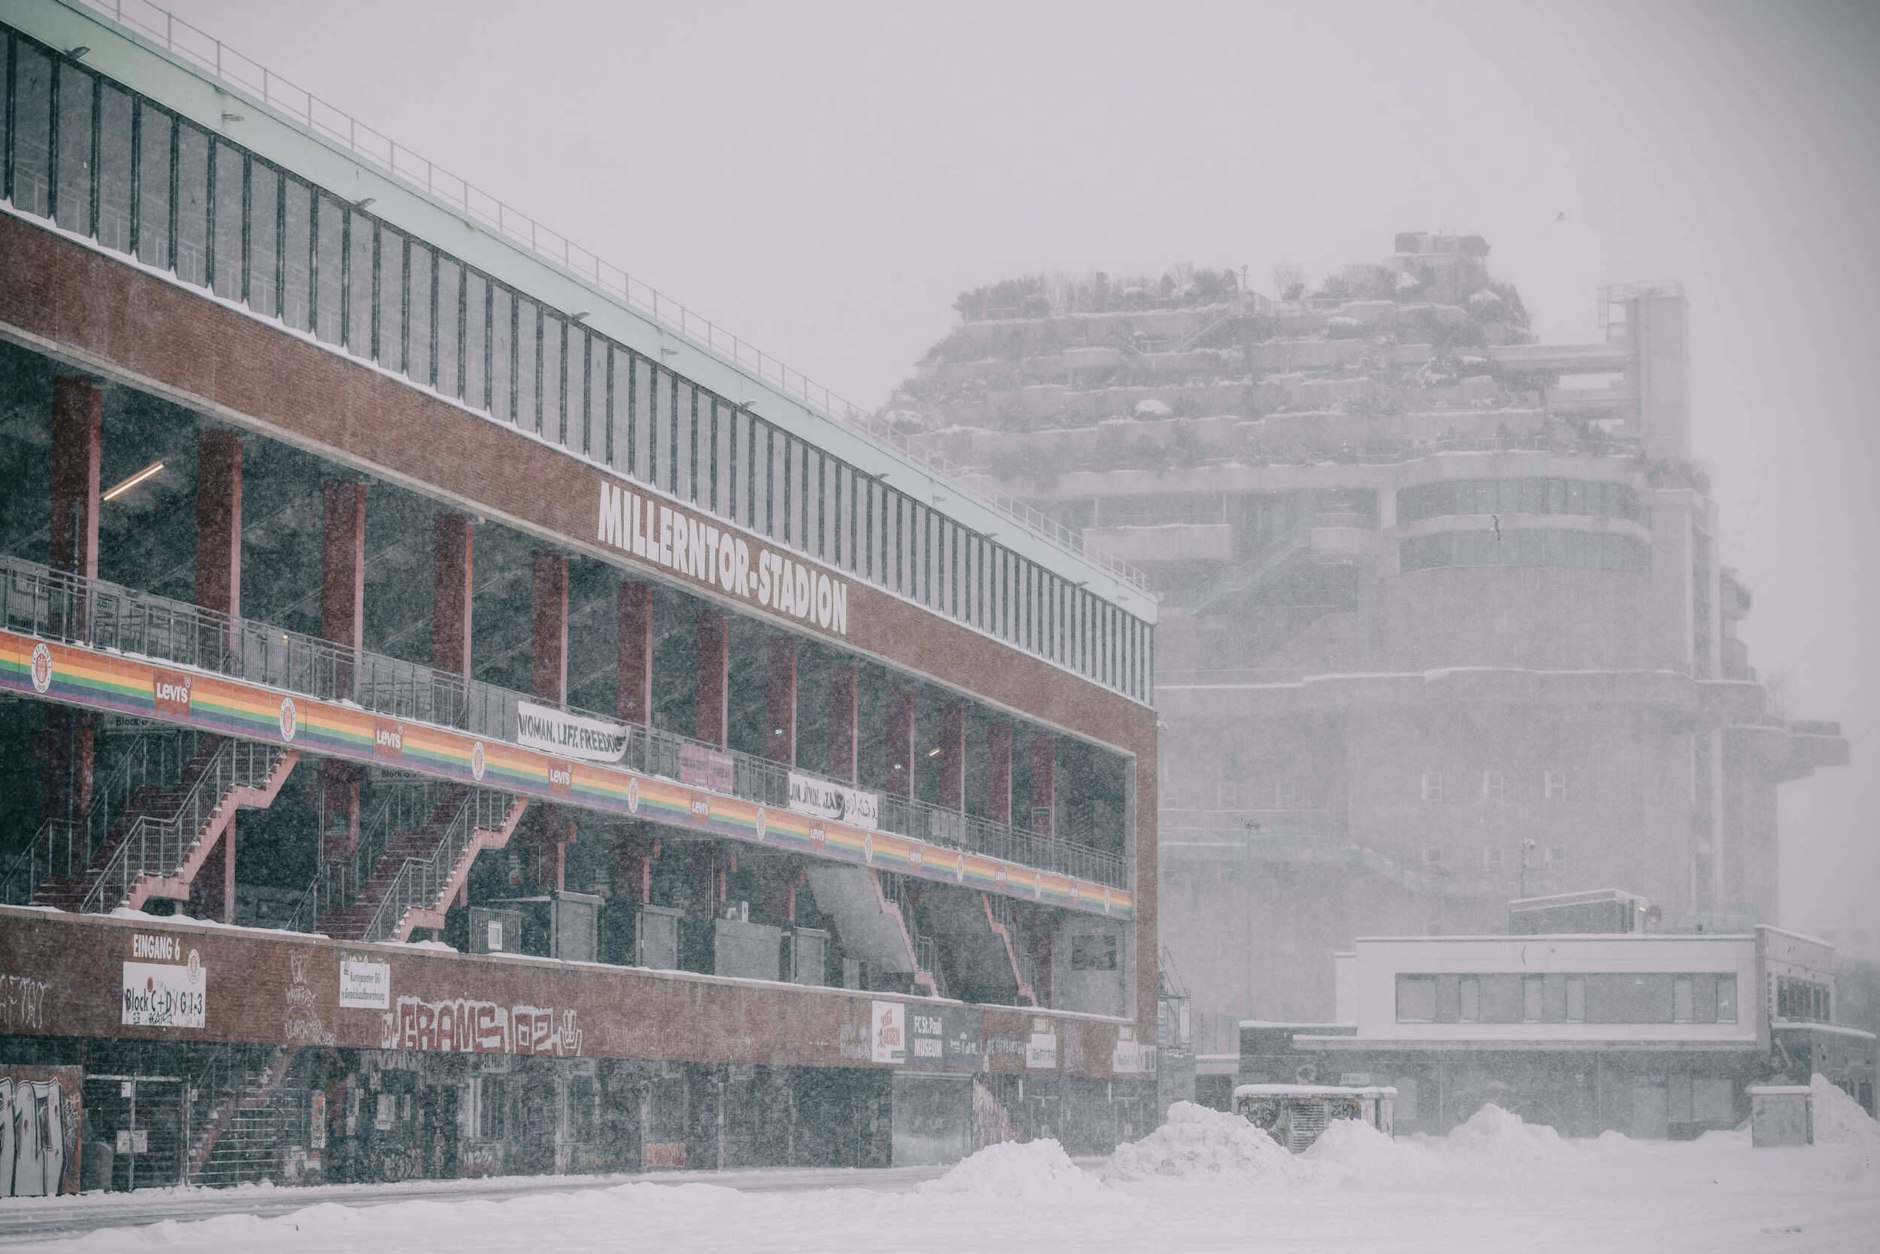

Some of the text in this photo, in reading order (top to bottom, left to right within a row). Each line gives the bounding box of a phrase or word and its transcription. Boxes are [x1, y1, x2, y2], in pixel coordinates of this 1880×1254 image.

[597, 480, 847, 635] MILLERNTOR-STADION
[518, 713, 555, 743] WOMAN.
[133, 934, 180, 960] EINGANG 6
[126, 987, 148, 1012] Block
[151, 990, 156, 1012] C
[166, 990, 172, 1014] D
[180, 992, 186, 1012] G
[914, 1038, 942, 1058] MUSEUM
